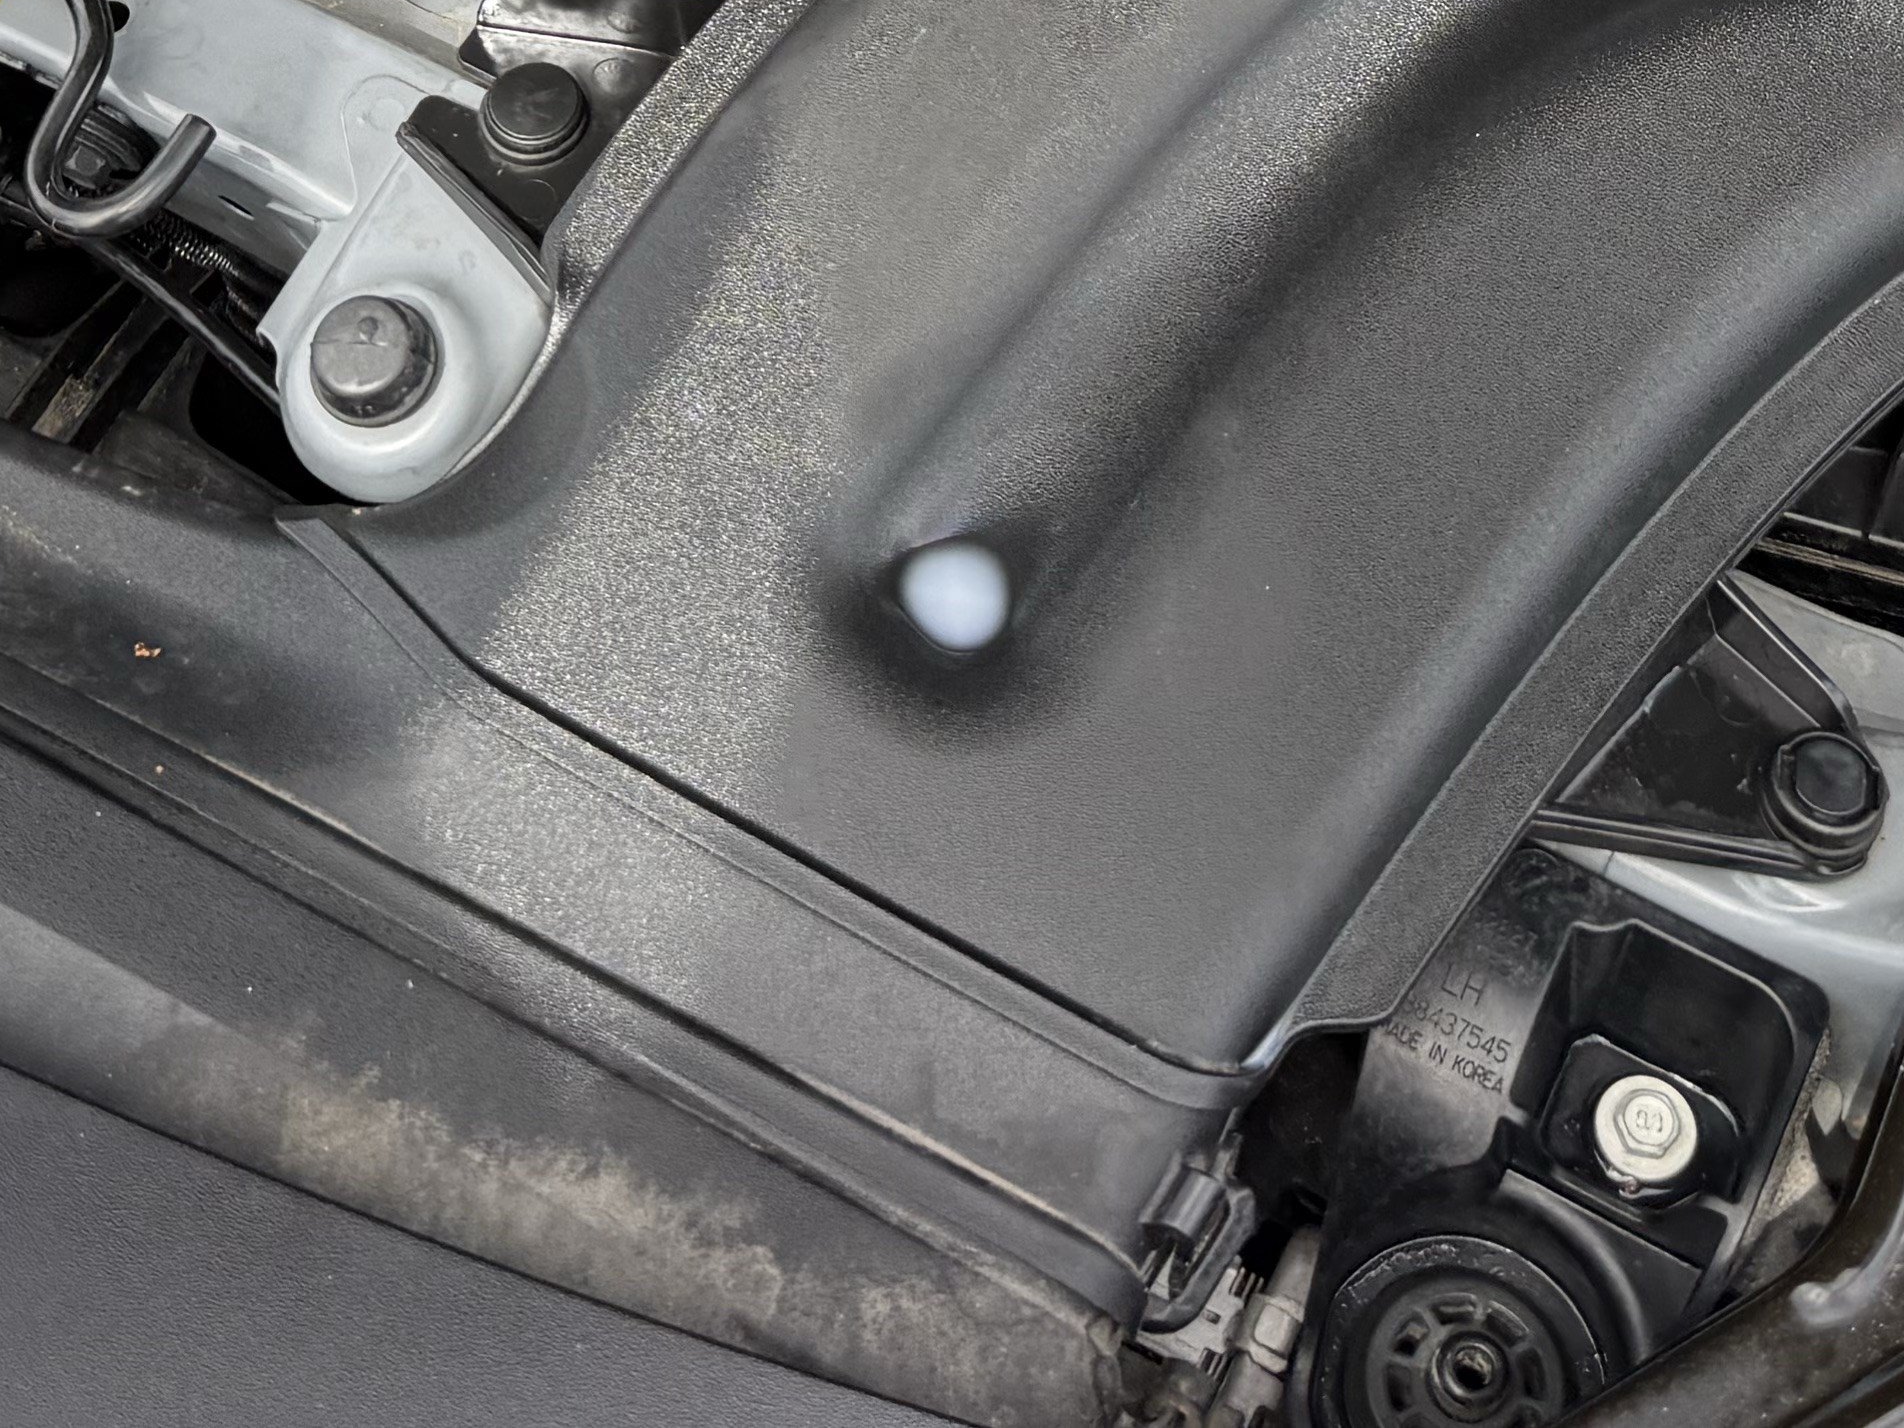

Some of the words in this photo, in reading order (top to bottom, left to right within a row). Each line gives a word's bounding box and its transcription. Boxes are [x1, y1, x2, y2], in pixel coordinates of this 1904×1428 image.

[1440, 964, 1486, 1008] LH
[1428, 1044, 1449, 1067] IN
[1450, 1055, 1505, 1096] KOREA
